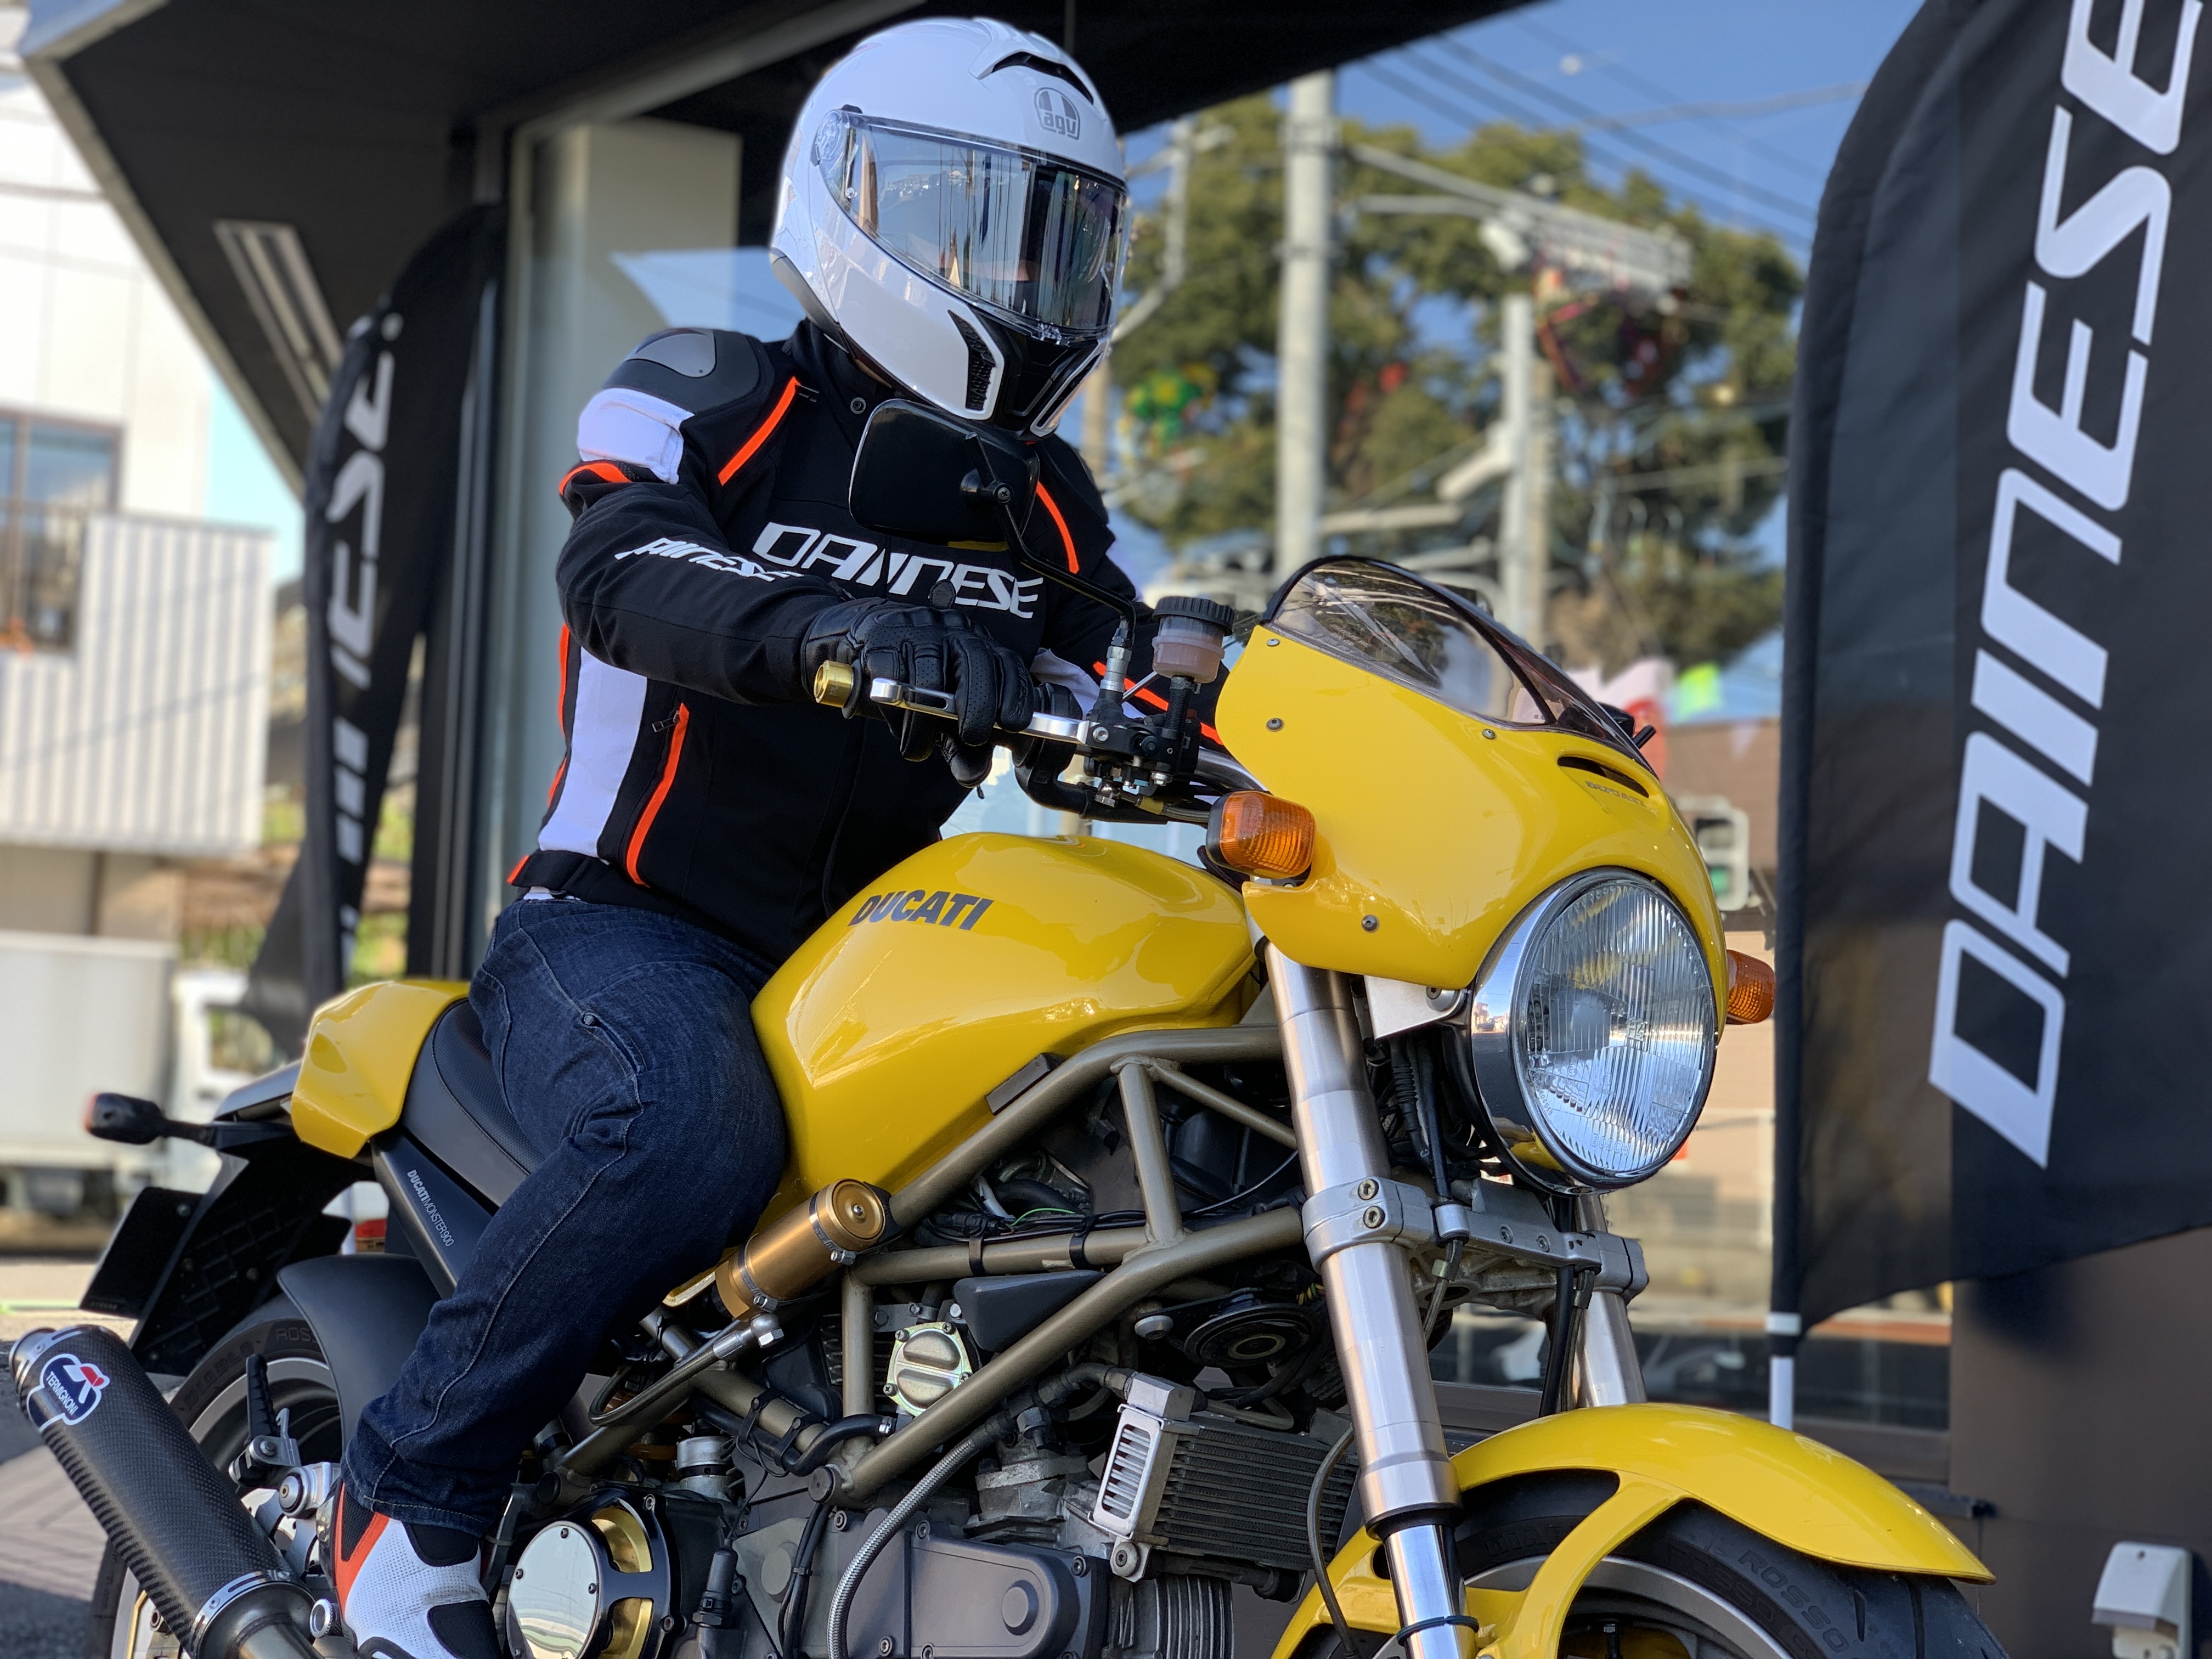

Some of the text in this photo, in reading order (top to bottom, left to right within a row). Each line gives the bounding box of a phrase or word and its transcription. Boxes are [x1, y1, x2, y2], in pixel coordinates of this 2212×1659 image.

[1043, 111, 1076, 136] agv
[752, 522, 1043, 619] DAINESE
[1928, 0, 2202, 1169] DAINESE
[847, 889, 995, 932] DUCATI
[1590, 1133, 1630, 1156] BOSCH
[276, 1327, 318, 1342] ROS
[46, 1370, 79, 1416] TERMIGNONI
[1738, 1549, 1850, 1654] ROSSO
